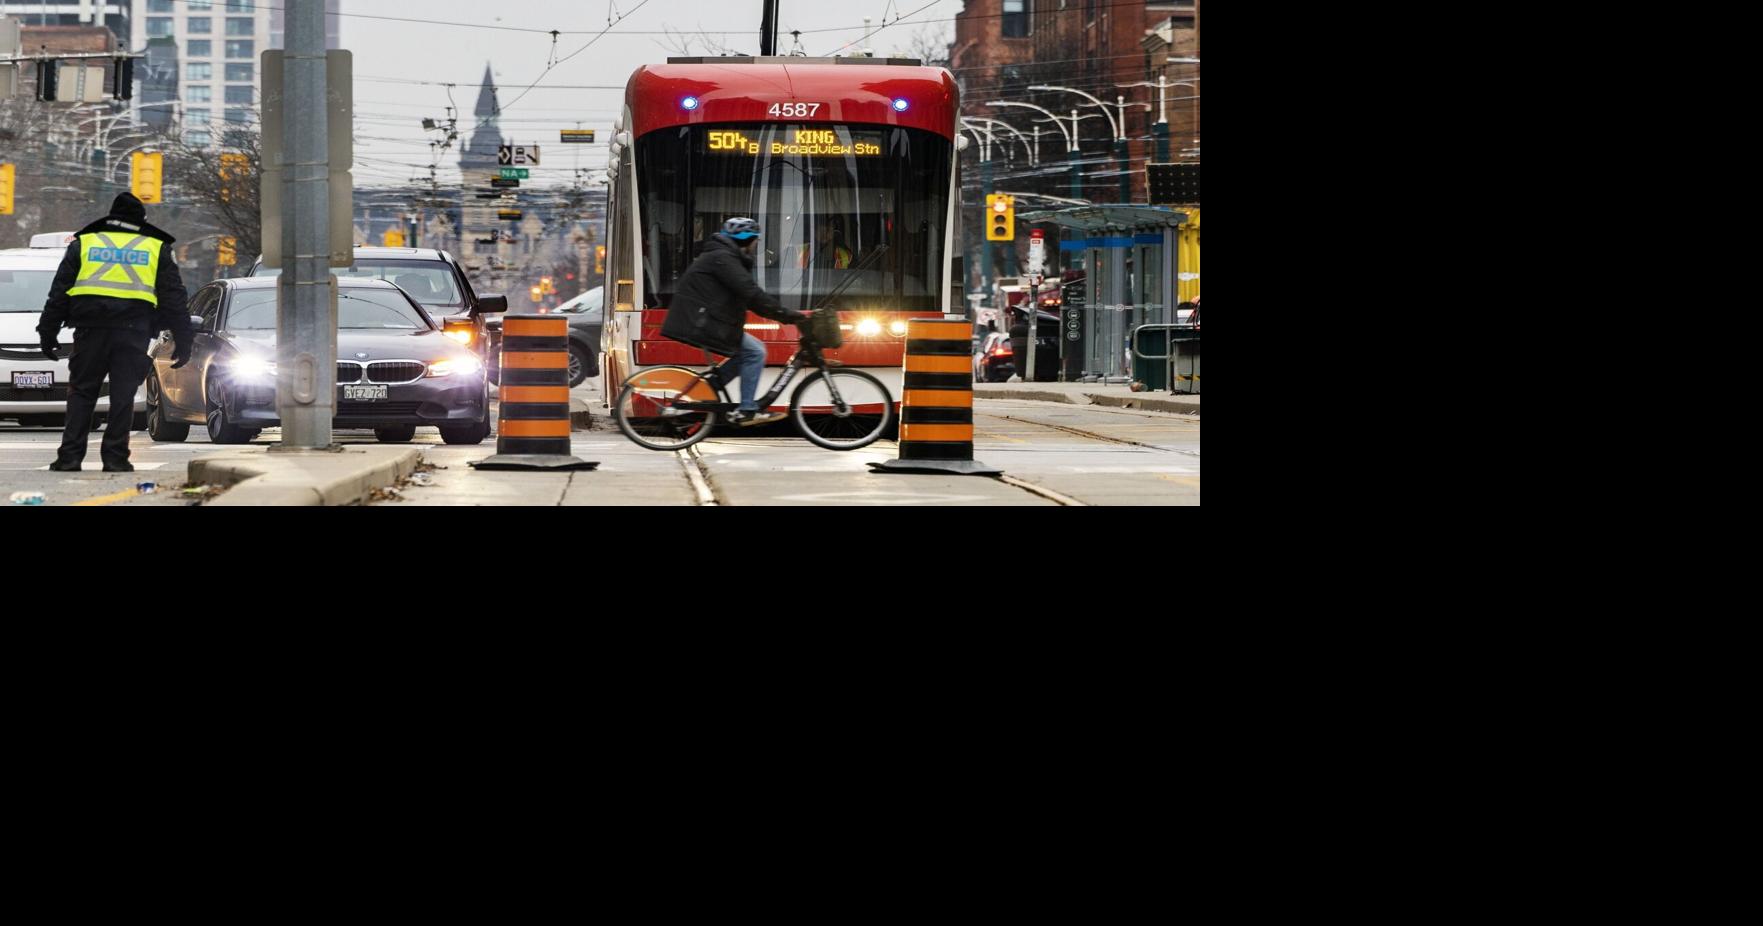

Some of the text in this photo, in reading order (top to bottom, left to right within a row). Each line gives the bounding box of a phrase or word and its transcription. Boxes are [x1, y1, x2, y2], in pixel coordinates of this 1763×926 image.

[769, 102, 820, 117] 4587
[709, 132, 748, 149] 504
[795, 130, 835, 144] KING
[771, 143, 880, 155] Broadview Stn
[90, 248, 147, 263] POLICE
